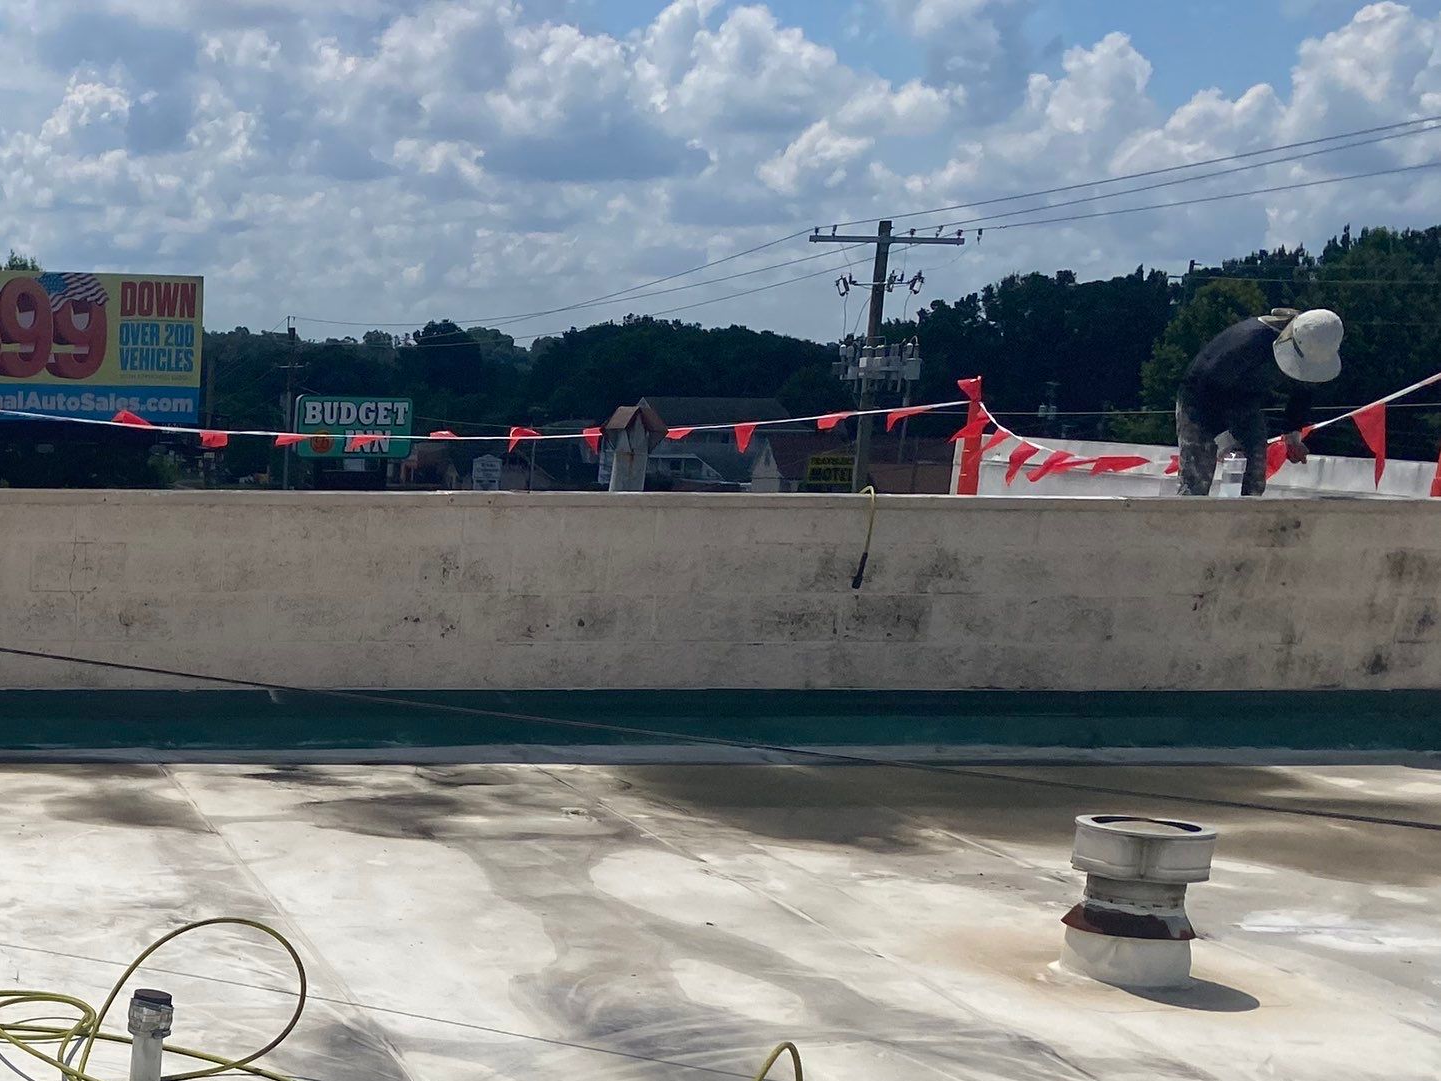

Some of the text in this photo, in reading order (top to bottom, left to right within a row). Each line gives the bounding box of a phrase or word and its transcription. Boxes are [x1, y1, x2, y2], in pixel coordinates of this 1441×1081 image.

[120, 281, 196, 318] DOWN
[119, 322, 195, 347] OVER 200
[119, 347, 195, 372] VEHICLES
[304, 401, 409, 425] BUDGET
